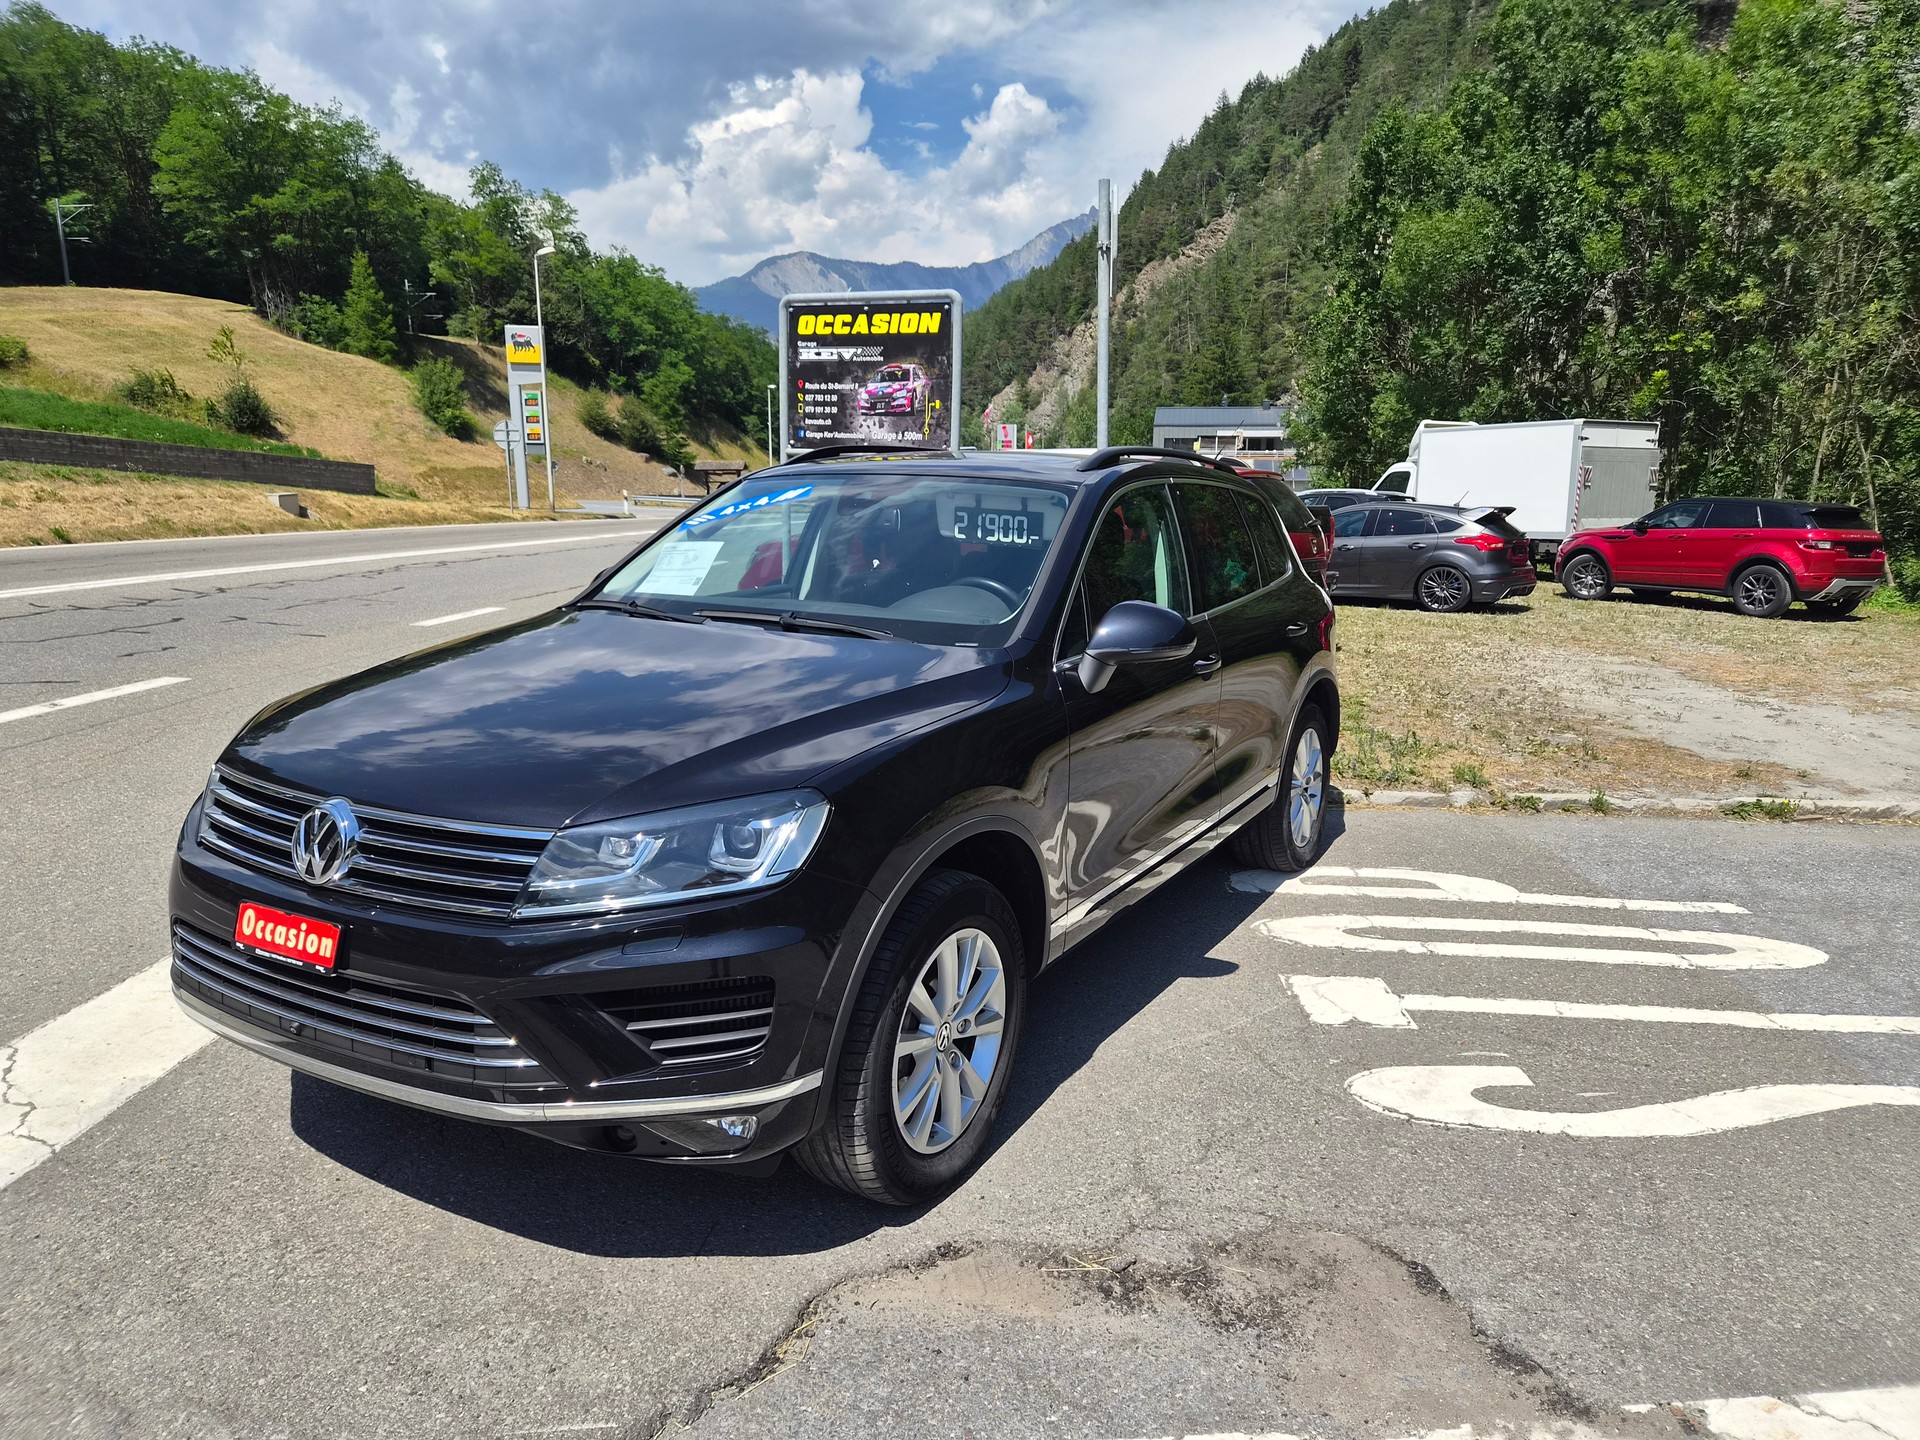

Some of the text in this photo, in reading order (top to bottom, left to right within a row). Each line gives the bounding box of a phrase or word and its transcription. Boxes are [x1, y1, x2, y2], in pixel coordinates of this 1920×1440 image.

[797, 312, 942, 335] OCCASION
[805, 382, 820, 390] Route
[820, 382, 827, 390] du
[828, 382, 855, 390] St-Bernard
[805, 431, 824, 439] Garage
[872, 431, 923, 441] Garage à 500m
[719, 496, 770, 516] 4x4
[241, 908, 333, 958] Occasion
